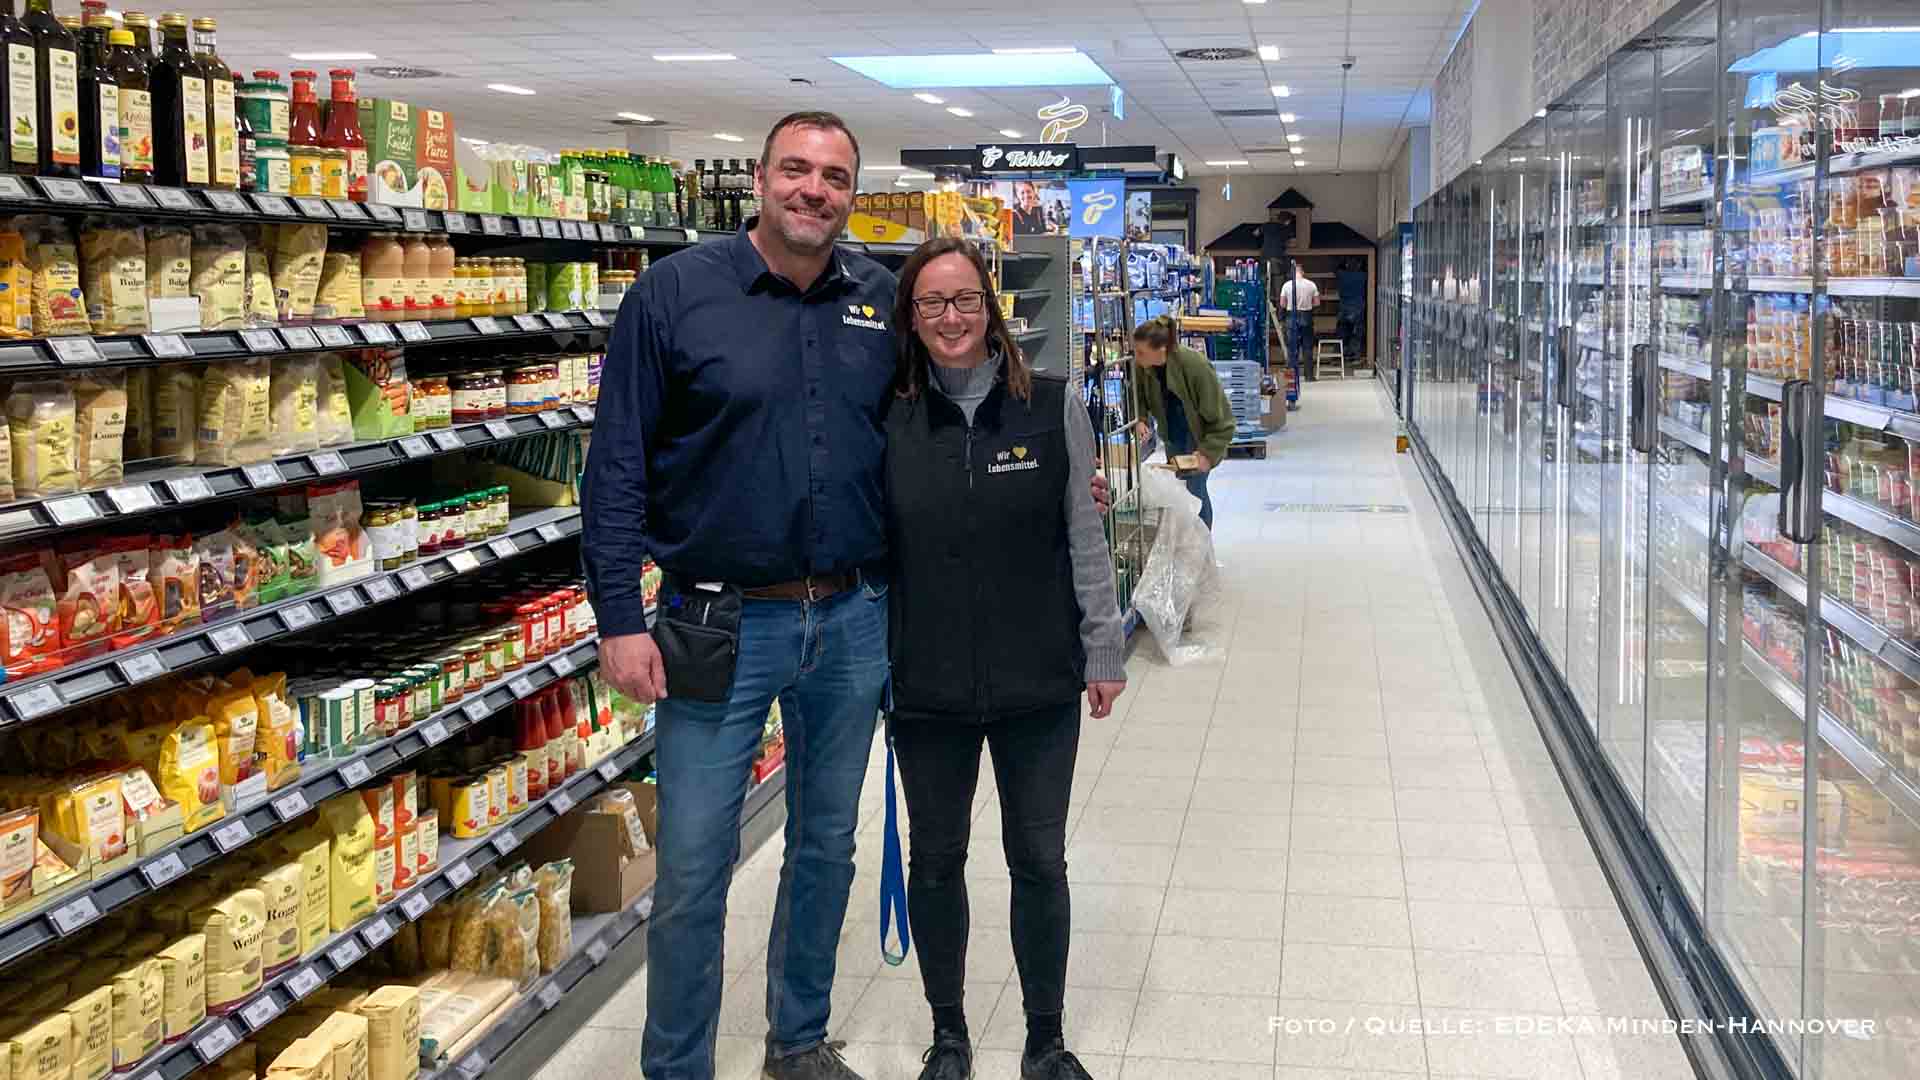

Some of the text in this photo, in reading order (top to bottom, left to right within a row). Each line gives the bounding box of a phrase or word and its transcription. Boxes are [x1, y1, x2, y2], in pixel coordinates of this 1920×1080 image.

[1005, 150, 1070, 167] Tchibo
[848, 304, 861, 315] Wir
[996, 450, 1010, 462] Wir
